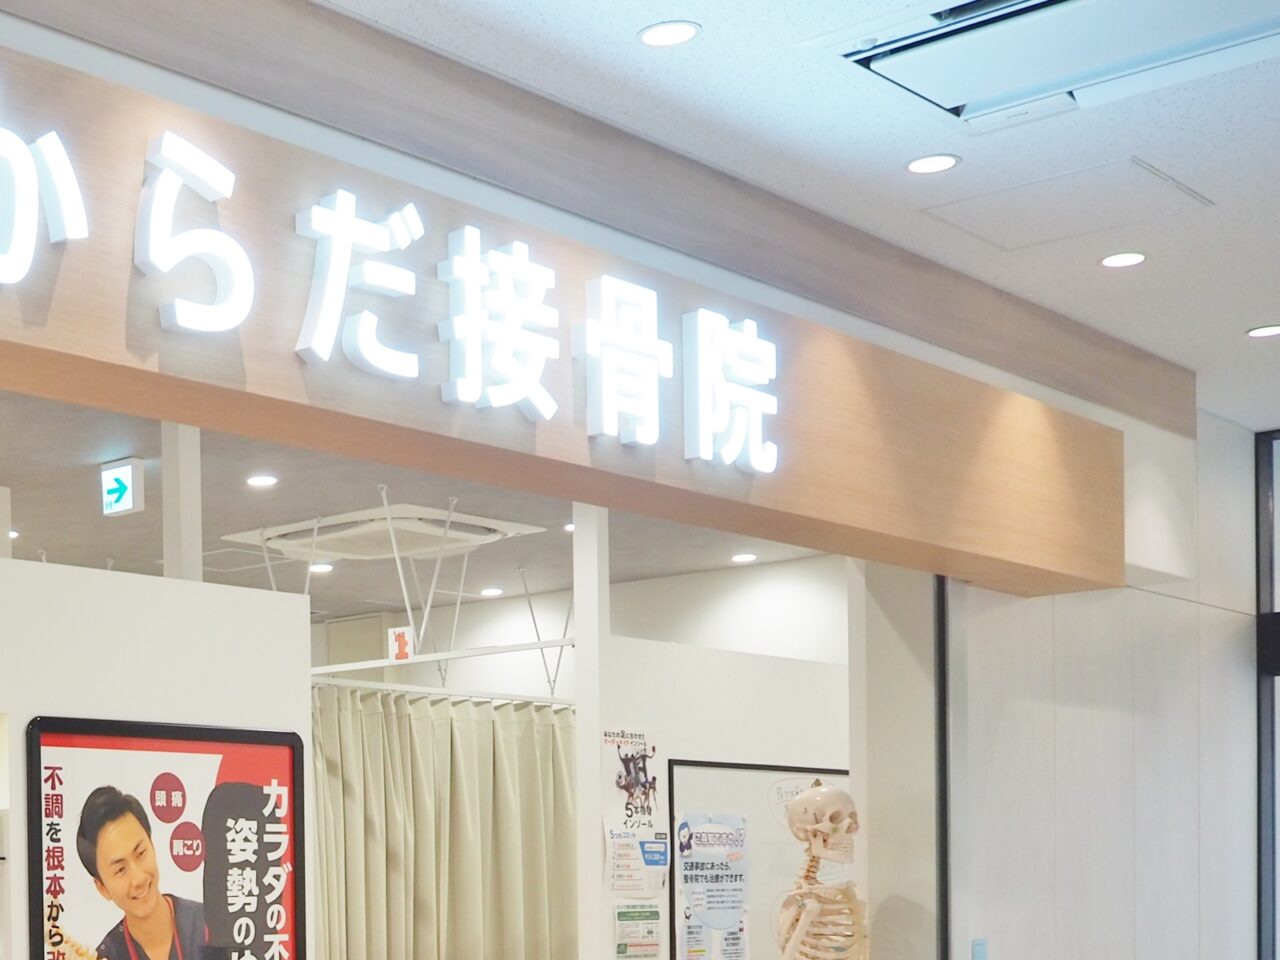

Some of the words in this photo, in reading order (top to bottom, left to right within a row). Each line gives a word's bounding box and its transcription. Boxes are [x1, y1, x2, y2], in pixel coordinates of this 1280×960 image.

[155, 789, 183, 808] 頭痛
[172, 838, 202, 857] 肩こり
